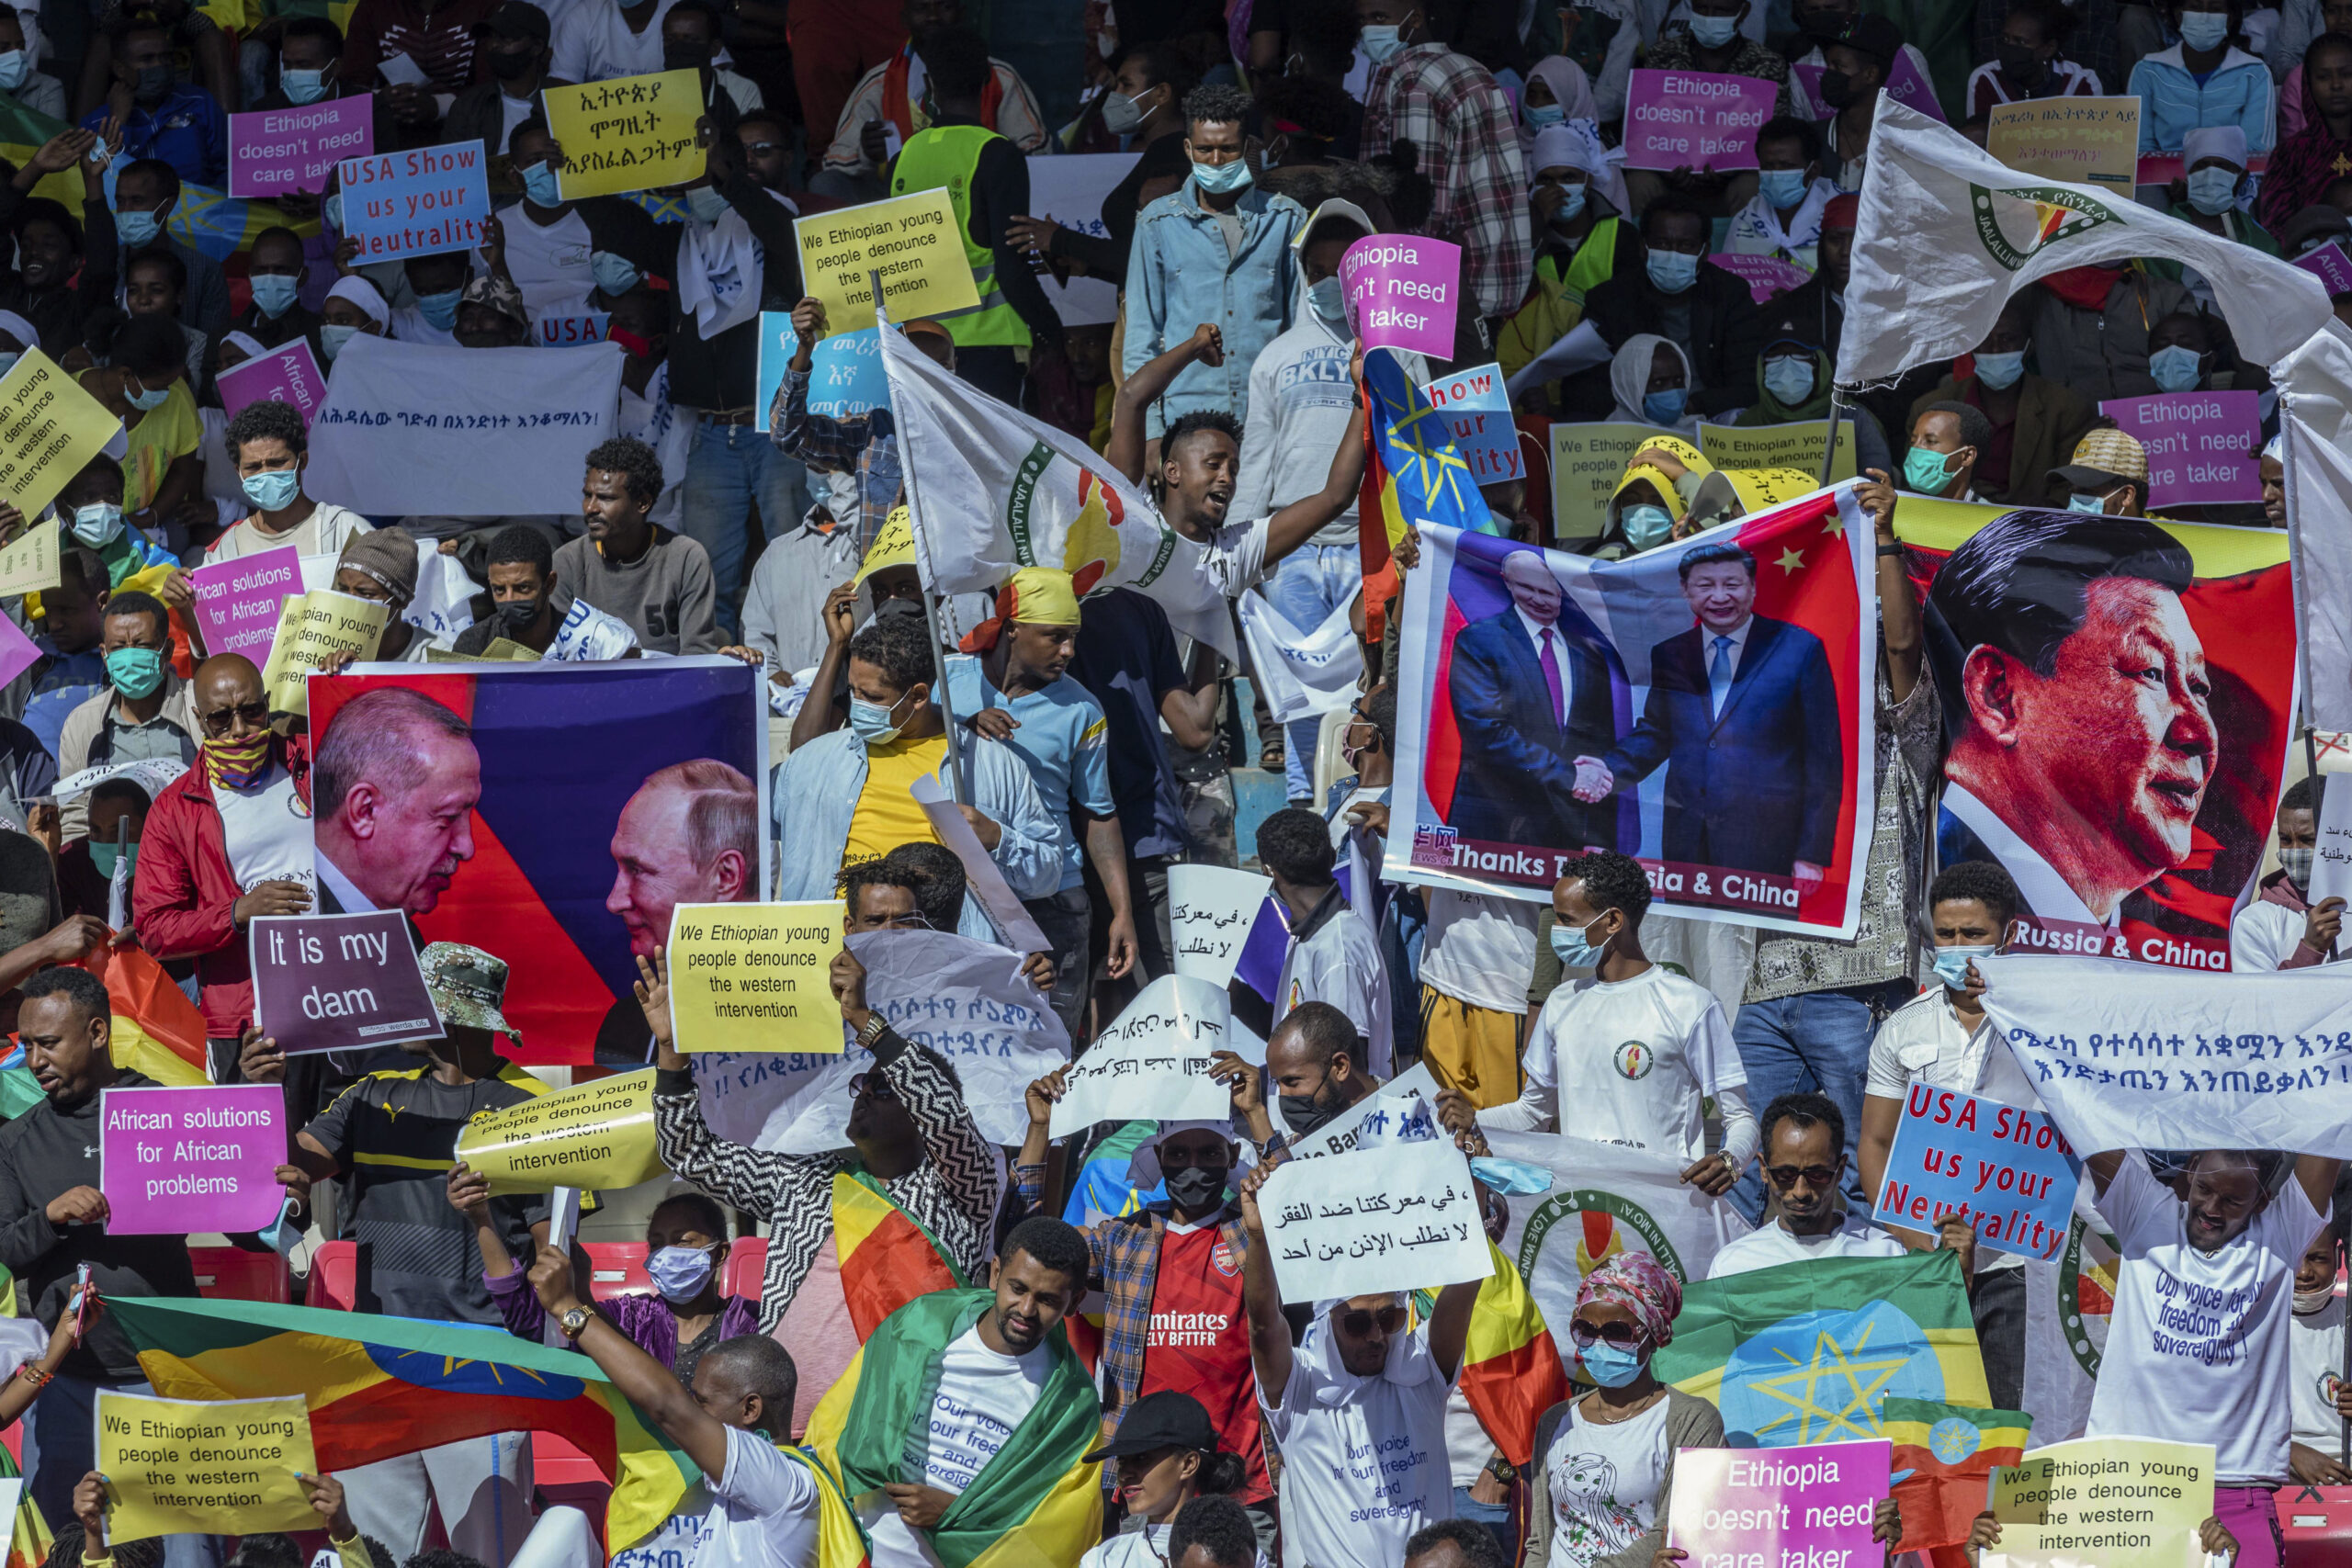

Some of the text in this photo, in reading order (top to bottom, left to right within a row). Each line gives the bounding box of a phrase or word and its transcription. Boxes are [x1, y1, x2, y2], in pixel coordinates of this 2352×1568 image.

[581, 82, 662, 111] ኢትዮጵያ
[1663, 76, 1741, 97] Ethiopia
[264, 108, 340, 133] Ethiopia
[590, 110, 662, 140] ሞግዚት
[1634, 103, 1763, 127] doesn't need
[239, 127, 364, 159] doesn't need
[1646, 136, 1746, 155] care taker
[253, 166, 295, 182] care
[343, 150, 476, 186] USA Show
[368, 187, 467, 219] us your
[804, 210, 944, 250] We Ethiopian young
[816, 232, 937, 272] people denounce
[1346, 243, 1419, 280] Ethiopia
[838, 272, 861, 287] the
[1387, 277, 1446, 303] need
[543, 318, 598, 343] USA
[1369, 307, 1429, 332] taker
[13, 367, 50, 406] young
[280, 354, 313, 411] African
[1280, 360, 1351, 390] BKLY
[1428, 374, 1491, 409] how
[4, 390, 55, 445] denounce
[2138, 399, 2223, 425] Ethiopia
[16, 419, 58, 462] western
[1560, 440, 1582, 453] We
[1705, 436, 1726, 451] We
[1734, 436, 1795, 454] Ethiopian
[2200, 430, 2251, 451] need
[10, 433, 72, 496] intervention
[1572, 459, 1617, 476] people
[1717, 456, 1760, 469] people
[2187, 462, 2240, 484] taker
[1591, 478, 1612, 491] the
[1011, 484, 1024, 544] JAALALLI
[1152, 541, 1172, 573] WINS
[232, 566, 292, 592] solutions
[209, 598, 275, 626] for African
[223, 626, 276, 651] problems
[338, 615, 379, 639] young
[299, 627, 363, 655] denounce
[1450, 843, 1799, 908] Thanks & China
[1215, 909, 1238, 929] في
[269, 929, 388, 966] It is my
[681, 925, 830, 944] We Ethiopian young
[2015, 921, 2226, 970] Russia & China
[688, 950, 817, 970] people denounce
[1179, 938, 1232, 958] لا نطلب
[709, 976, 796, 992] the western
[301, 986, 379, 1020] dam
[716, 1001, 797, 1018] intervention
[2089, 1032, 2185, 1057] የተሳሳተ
[2180, 1066, 2329, 1095] እንጠይቃለን
[473, 1080, 648, 1128] We Ethiopian young
[482, 1099, 633, 1134] people denounce
[1908, 1084, 1977, 1133] USA
[107, 1106, 271, 1131] African solutions
[504, 1131, 532, 1144] the
[137, 1140, 242, 1163] for African
[509, 1145, 612, 1171] intervention
[1924, 1146, 2052, 1201] us your
[146, 1173, 239, 1201] problems
[1275, 1185, 1455, 1229] في معركتنا ضد الفقر
[1282, 1223, 1468, 1261] لا نطلب الإذن من أحد
[1520, 1213, 1549, 1279] LOVE WINS
[1149, 1309, 1228, 1330] mirates
[2158, 1298, 2221, 1337] freedom
[105, 1415, 294, 1442] We Ethiopian young
[930, 1420, 960, 1439] our
[119, 1446, 282, 1466] people denounce
[1375, 1435, 1409, 1455] voice
[943, 1450, 977, 1469] and
[1351, 1450, 1429, 1480] our freedom
[2004, 1459, 2199, 1485] We Ethiopian young
[146, 1470, 260, 1485] the western
[1728, 1456, 1840, 1493] Ethiopia
[153, 1492, 262, 1507] intervention
[1375, 1479, 1401, 1498] and
[2014, 1483, 2182, 1507] people denounce
[1805, 1497, 1873, 1529] need
[2039, 1509, 2154, 1525] the western
[2040, 1532, 2151, 1550] intervention
[1781, 1545, 1852, 1568] taker
